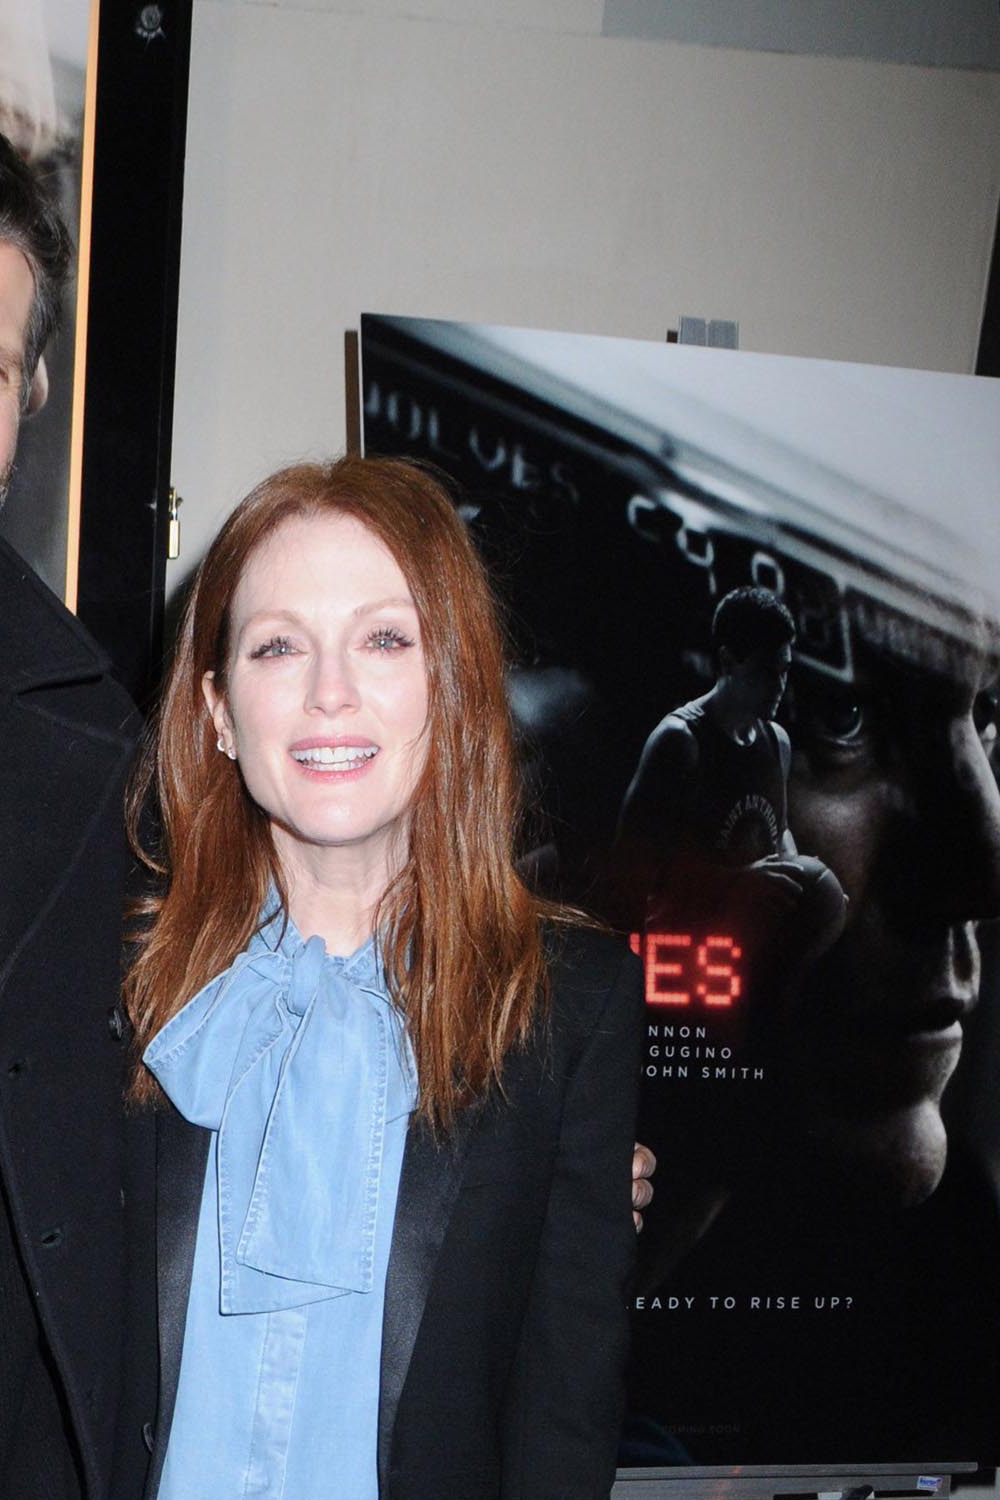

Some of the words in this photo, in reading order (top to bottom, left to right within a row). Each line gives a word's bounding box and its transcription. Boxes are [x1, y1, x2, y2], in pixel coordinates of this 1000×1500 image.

[630, 933, 741, 1005] ES
[648, 1025, 706, 1038] NNON
[649, 1045, 732, 1059] GUGINO
[640, 1065, 689, 1078] OHN
[701, 1066, 764, 1080] SMITH
[625, 1296, 695, 1310] EADY
[710, 1296, 736, 1310] TO
[750, 1296, 800, 1310] RISE
[815, 1296, 853, 1310] UP?
